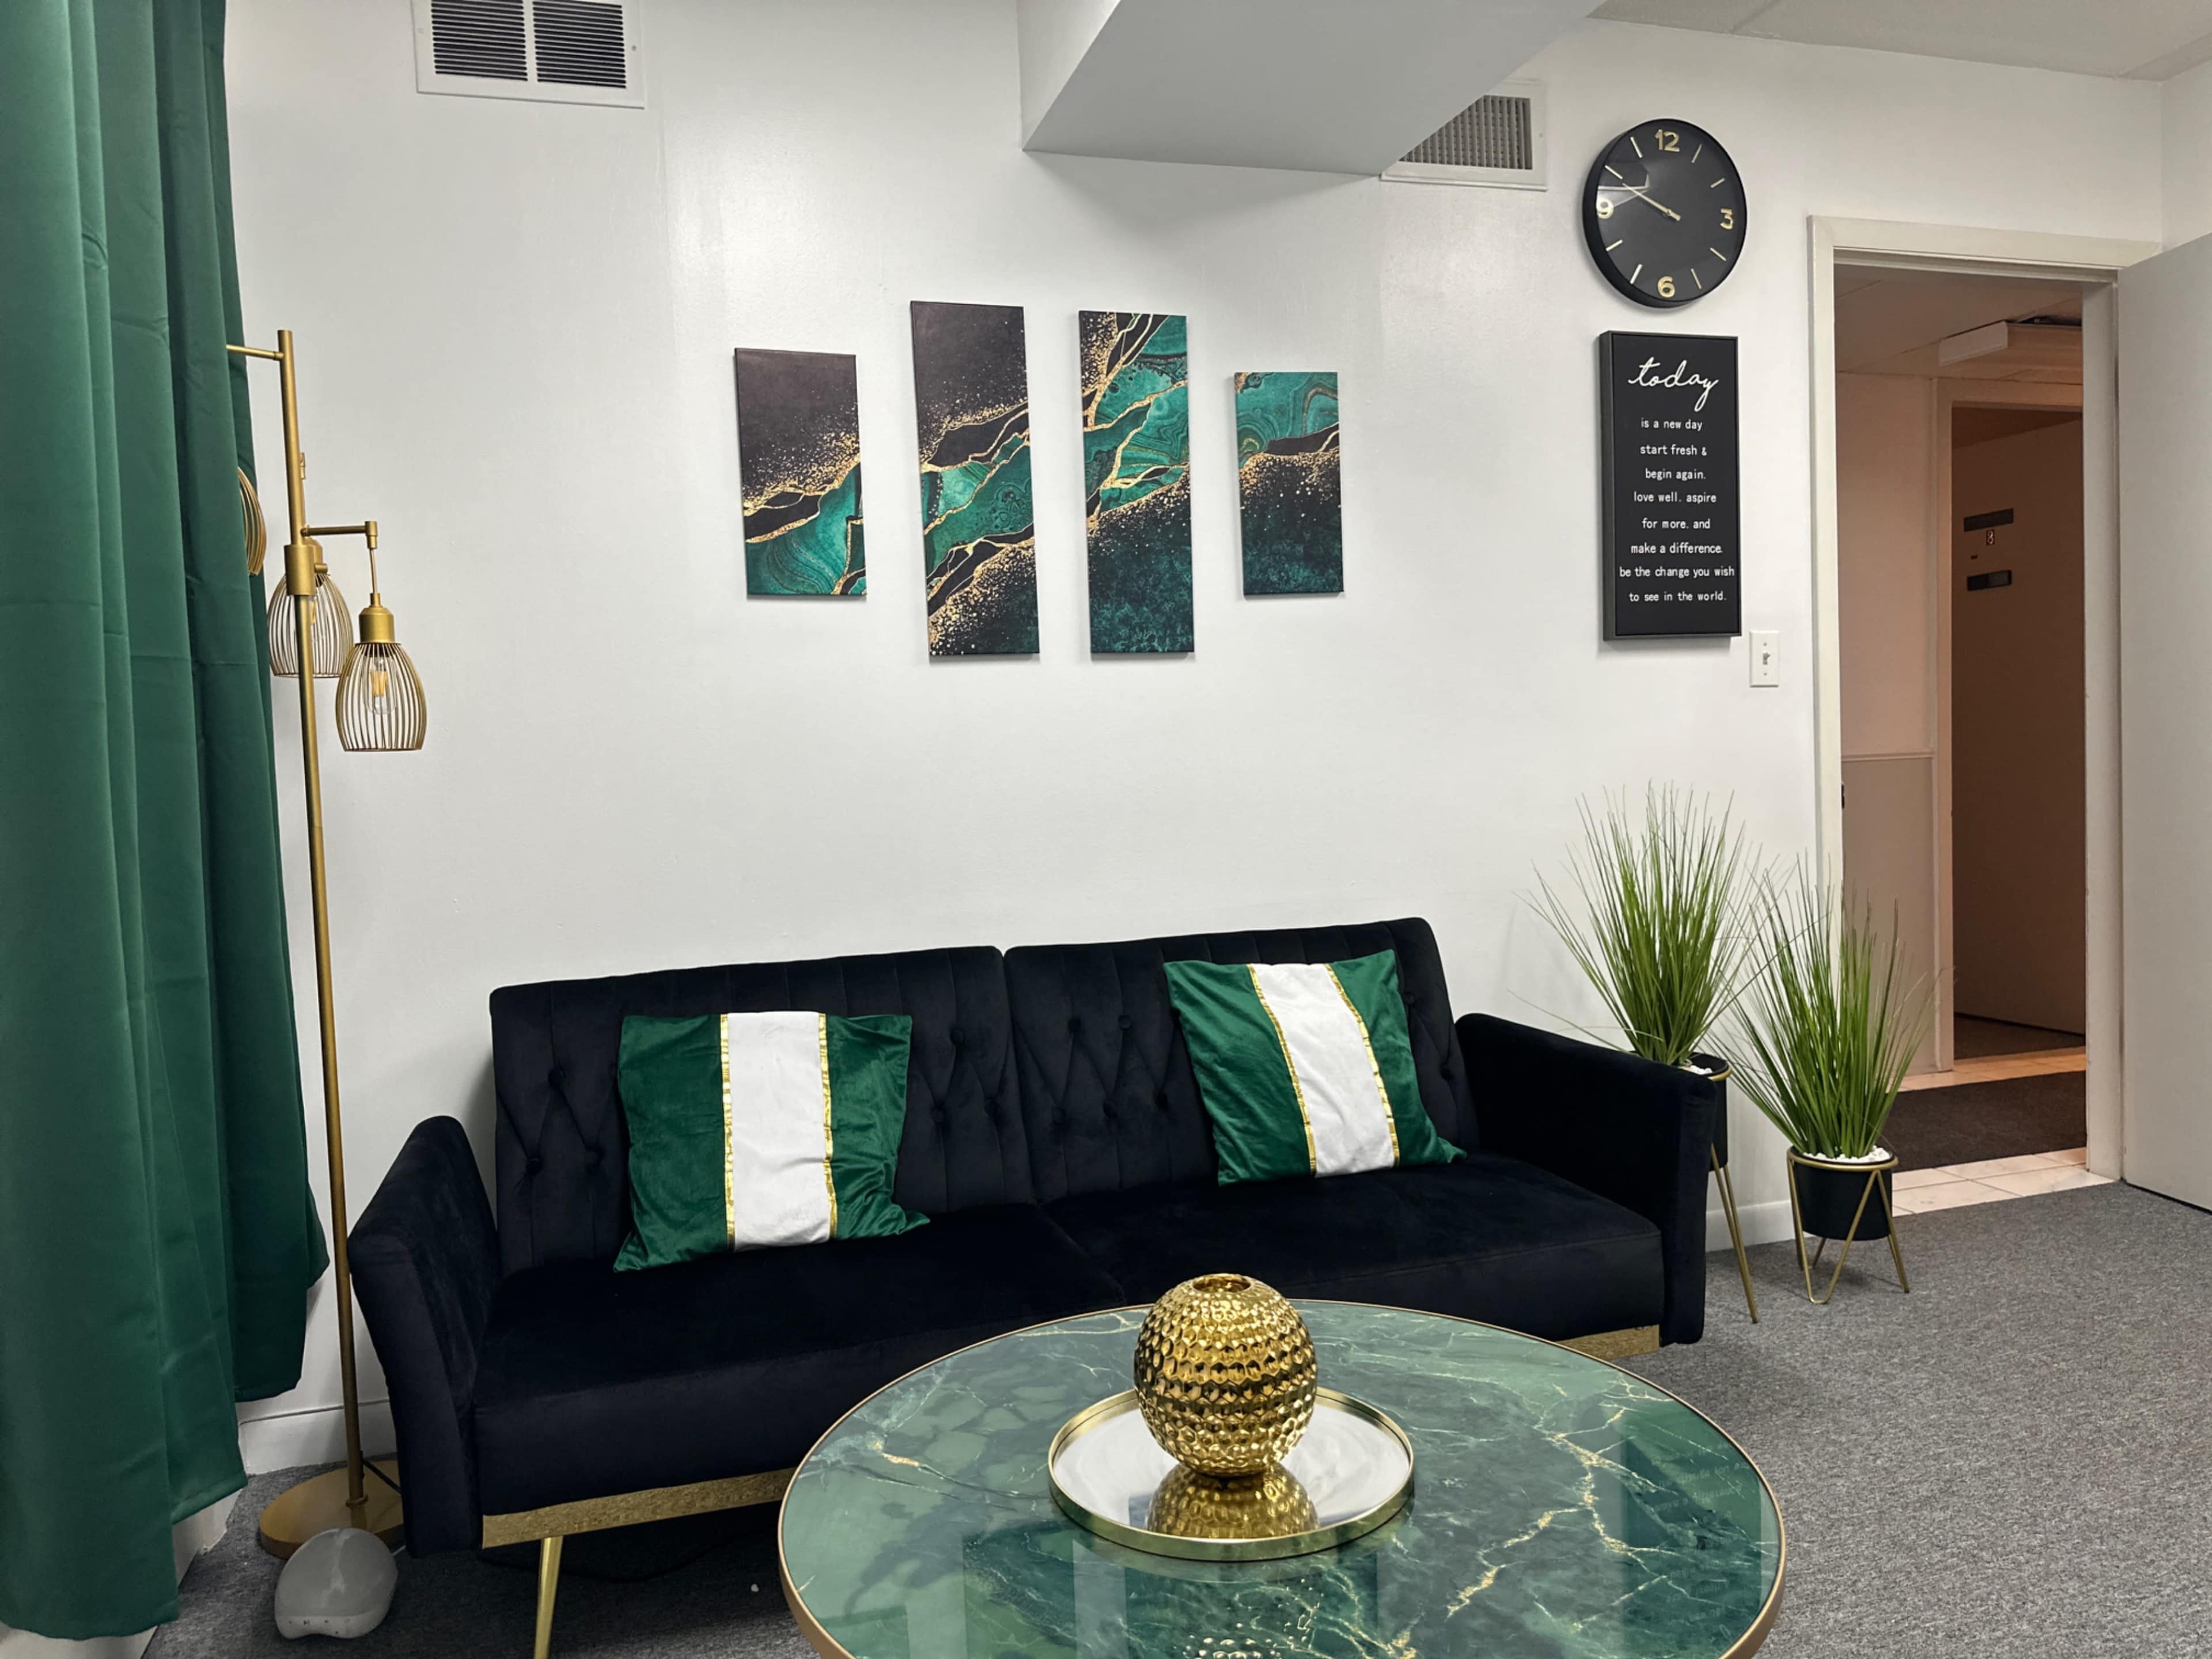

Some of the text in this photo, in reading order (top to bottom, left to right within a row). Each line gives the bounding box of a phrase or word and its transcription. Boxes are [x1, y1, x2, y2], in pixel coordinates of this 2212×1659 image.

[1655, 129, 1680, 152] 12
[1596, 196, 1614, 219] 9
[1721, 209, 1733, 229] 3
[1657, 276, 1676, 298] 6
[1627, 357, 1719, 412] today
[1641, 418, 1703, 431] is a new day
[1640, 444, 1707, 456] start fresh &
[1645, 468, 1706, 481] begin again.
[1634, 491, 1654, 502] love
[1686, 492, 1717, 504] aspire
[1642, 517, 1658, 529] for
[1693, 518, 1710, 529] and
[1631, 542, 1657, 554] make
[1660, 545, 1666, 554] a
[1619, 566, 1734, 579] be the change you wish
[1628, 593, 1639, 602] to
[1664, 591, 1673, 601] in
[1677, 591, 1693, 601] the
[1697, 590, 1728, 601] world.
